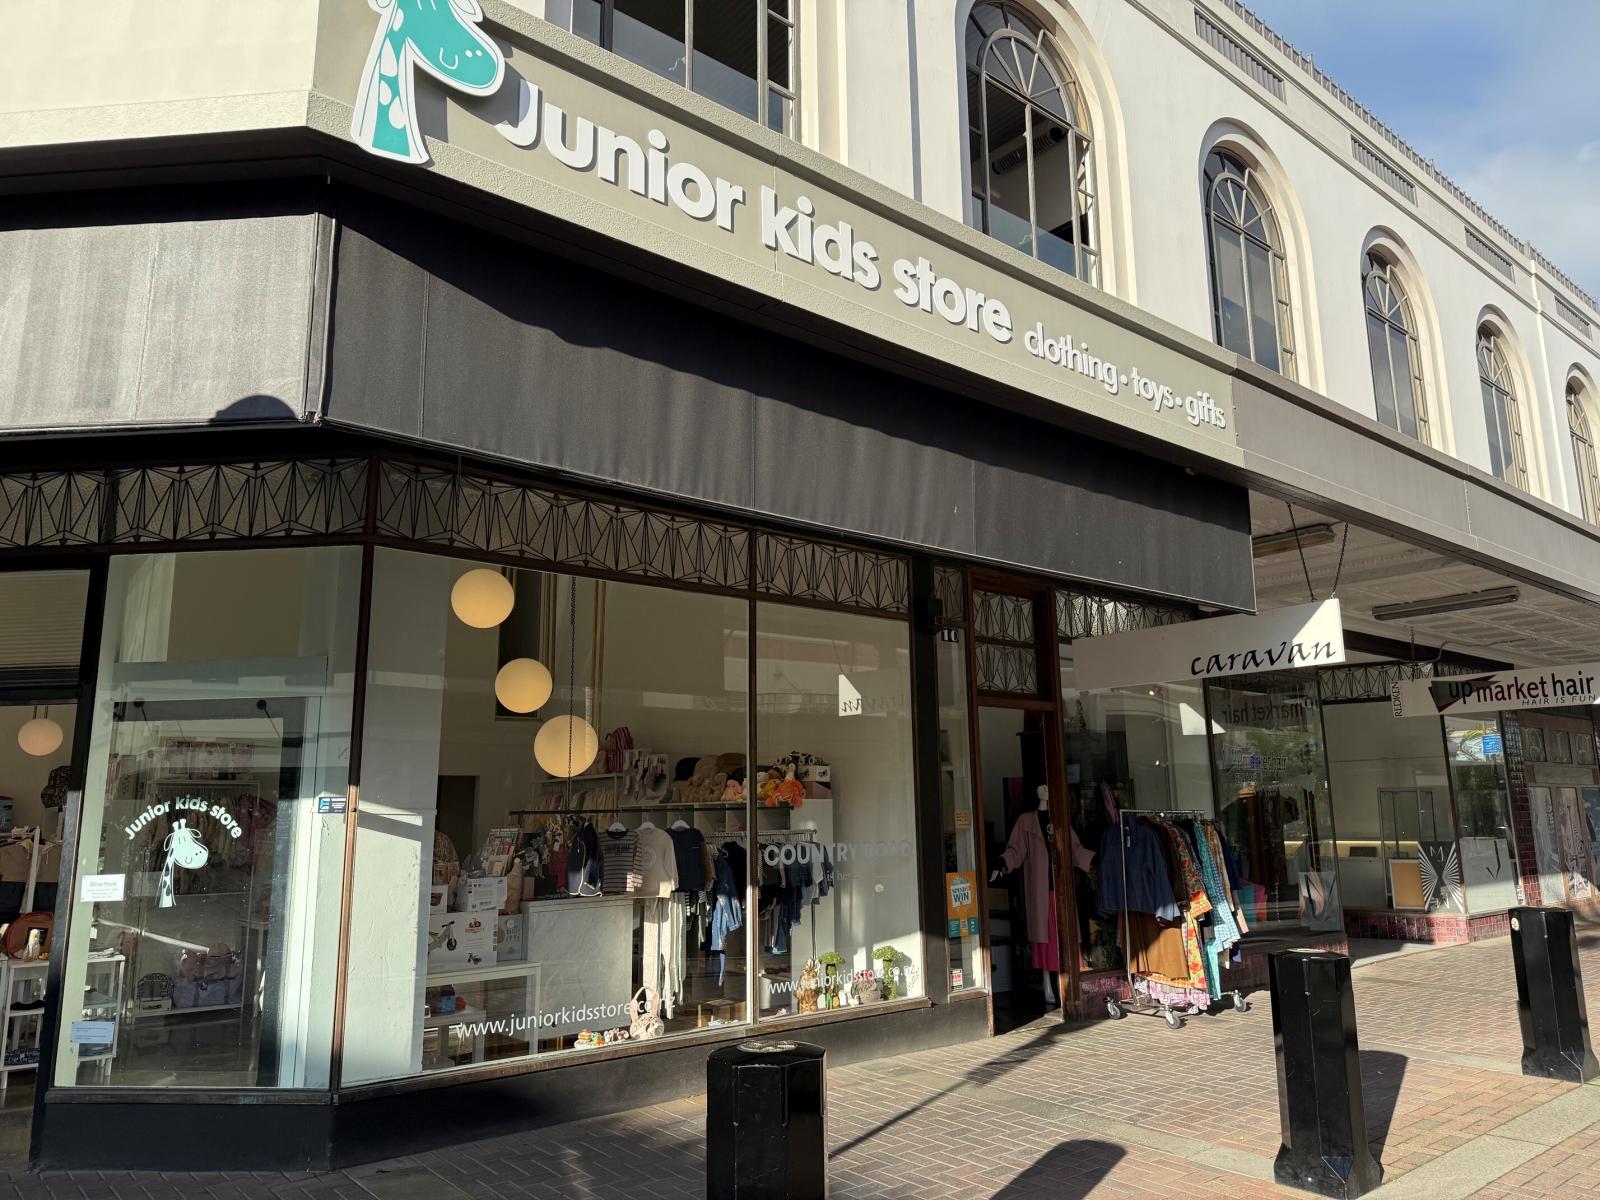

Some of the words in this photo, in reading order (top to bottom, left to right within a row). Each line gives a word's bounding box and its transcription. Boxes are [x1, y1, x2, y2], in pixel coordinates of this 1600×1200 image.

[494, 78, 744, 231] Junior
[761, 184, 881, 289] kids
[893, 256, 1013, 343] store
[942, 629, 959, 642] 10
[1190, 640, 1337, 676] caravan
[1551, 670, 1595, 697] hair
[1391, 681, 1403, 717] REDKEN
[1521, 697, 1551, 707] HAIR
[1555, 696, 1567, 704] IS
[1571, 694, 1597, 704] FUN
[124, 800, 171, 840] Junior
[175, 794, 208, 812] kids
[209, 804, 242, 839] store
[763, 842, 857, 867] COUNTRY
[953, 892, 969, 903] WIN
